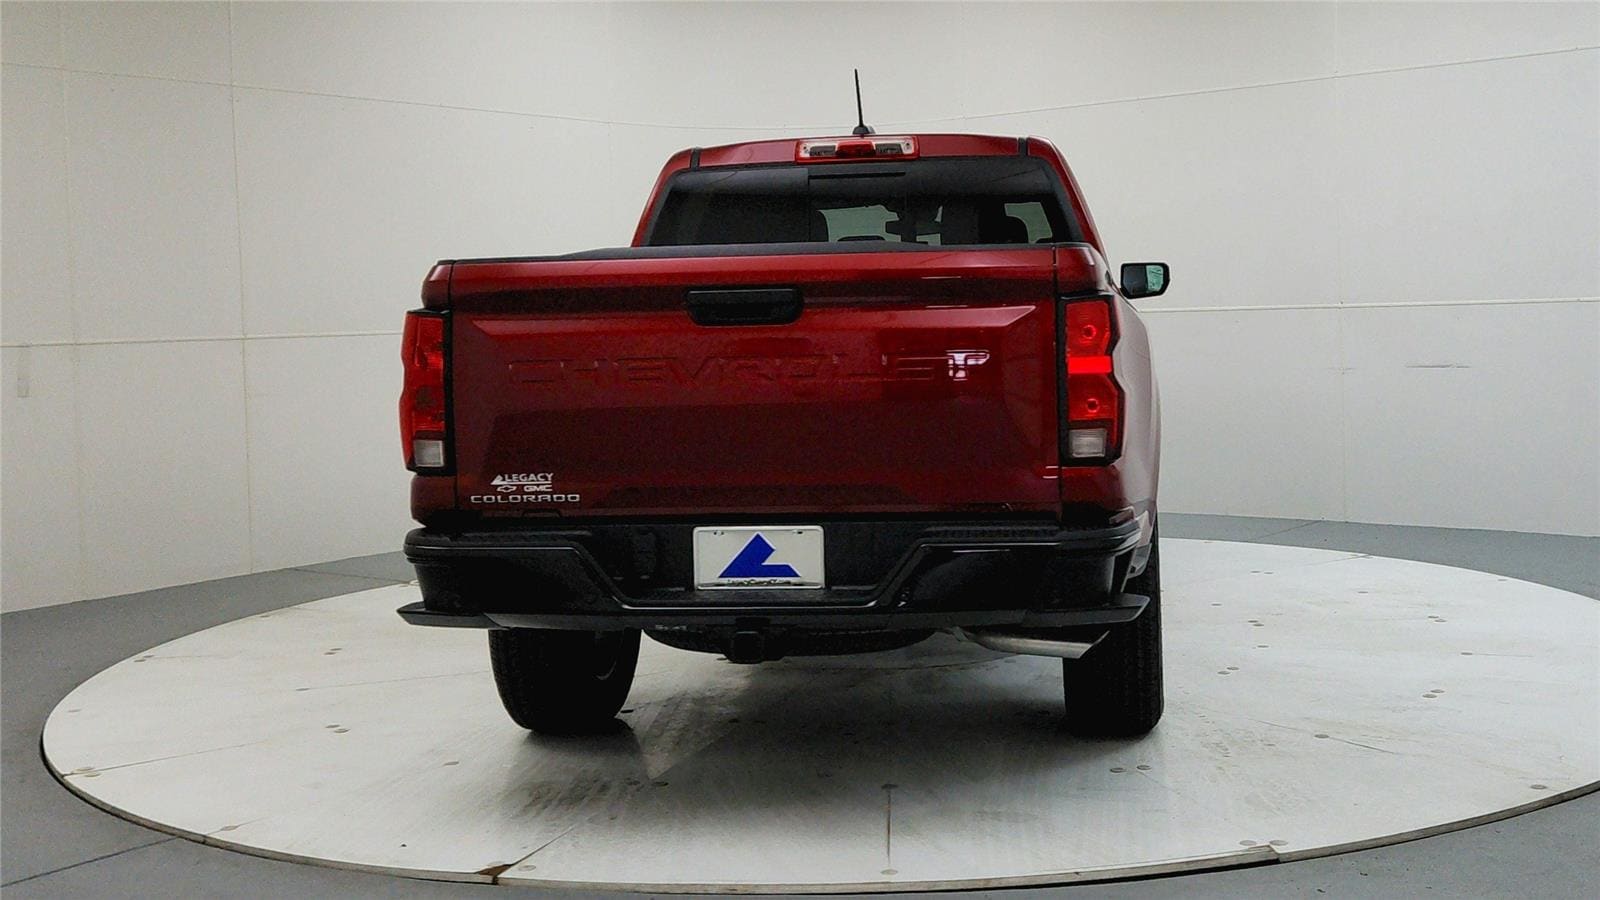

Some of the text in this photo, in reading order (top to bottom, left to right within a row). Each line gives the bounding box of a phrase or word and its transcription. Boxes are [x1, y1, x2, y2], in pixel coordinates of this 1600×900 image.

[507, 349, 990, 389] CHEVROLET
[504, 472, 554, 482] LEGACY
[523, 484, 553, 492] GMC
[470, 494, 581, 503] COLORADO
